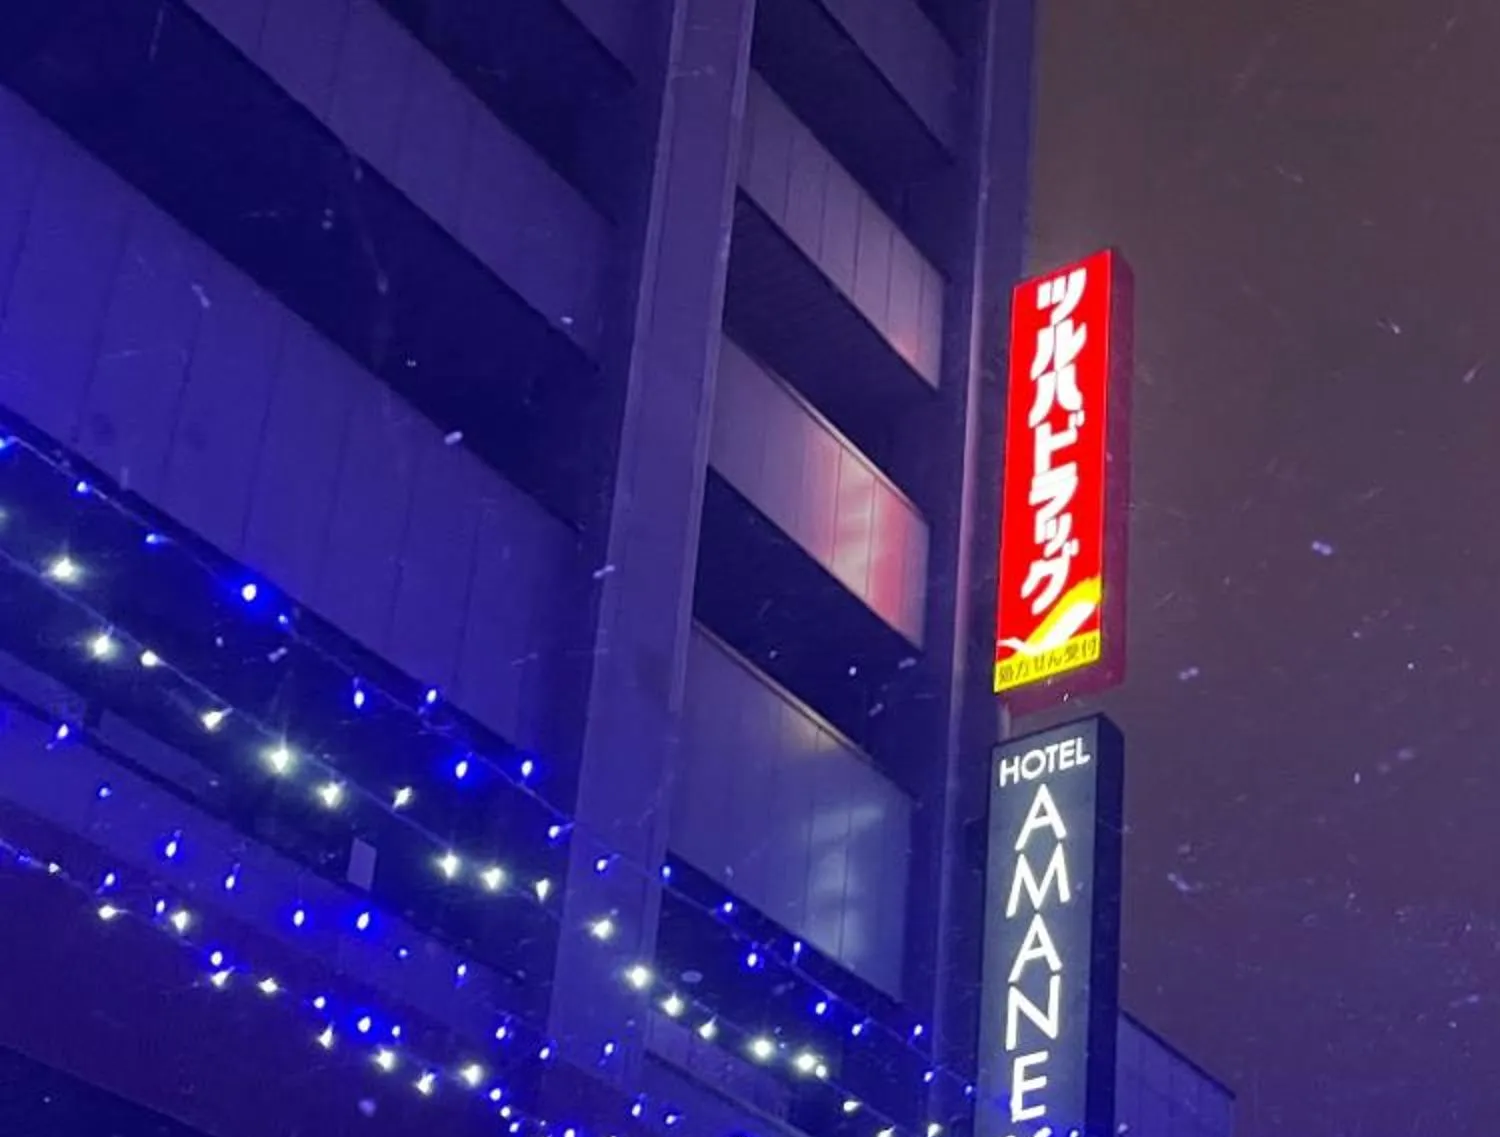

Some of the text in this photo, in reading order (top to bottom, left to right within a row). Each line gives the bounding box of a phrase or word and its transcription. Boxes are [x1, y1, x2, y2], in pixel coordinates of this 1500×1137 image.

[1021, 268, 1087, 615] ツルハドラッグ
[1000, 737, 1090, 787] HOTEL
